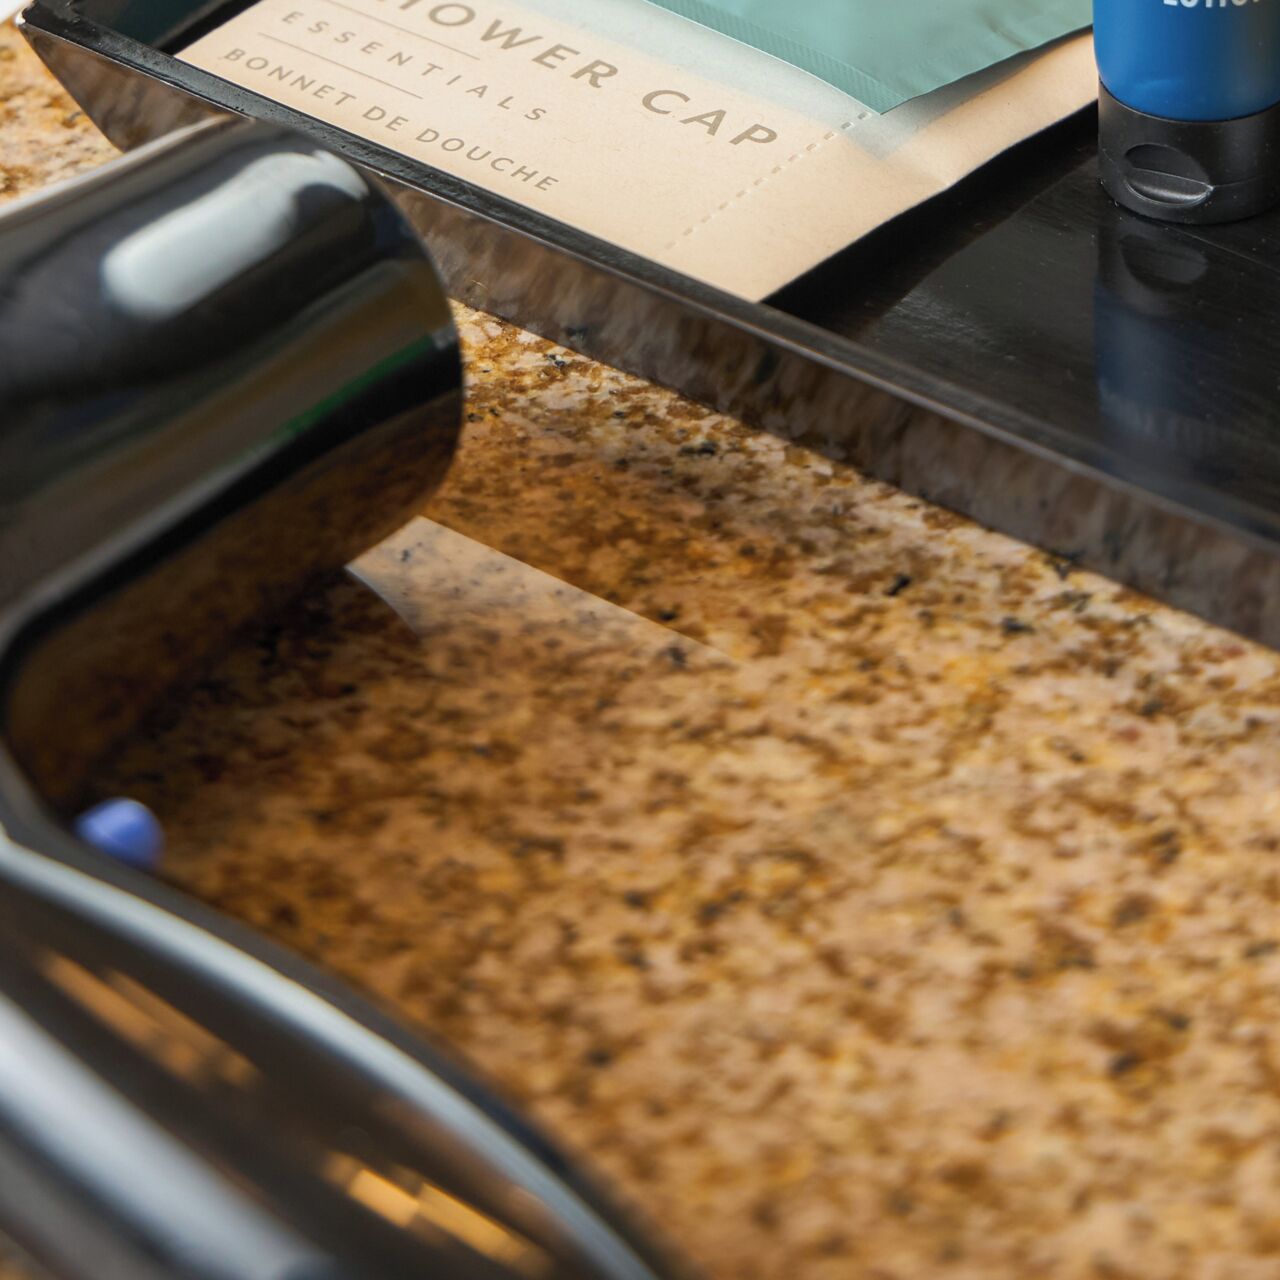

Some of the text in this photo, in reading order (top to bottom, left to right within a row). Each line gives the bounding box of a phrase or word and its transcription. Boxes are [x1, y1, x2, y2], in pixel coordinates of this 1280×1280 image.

[223, 48, 559, 192] BONNET DE DOUCHE
[281, 11, 547, 121] ESSENTIALS
[642, 89, 778, 146] CAP
